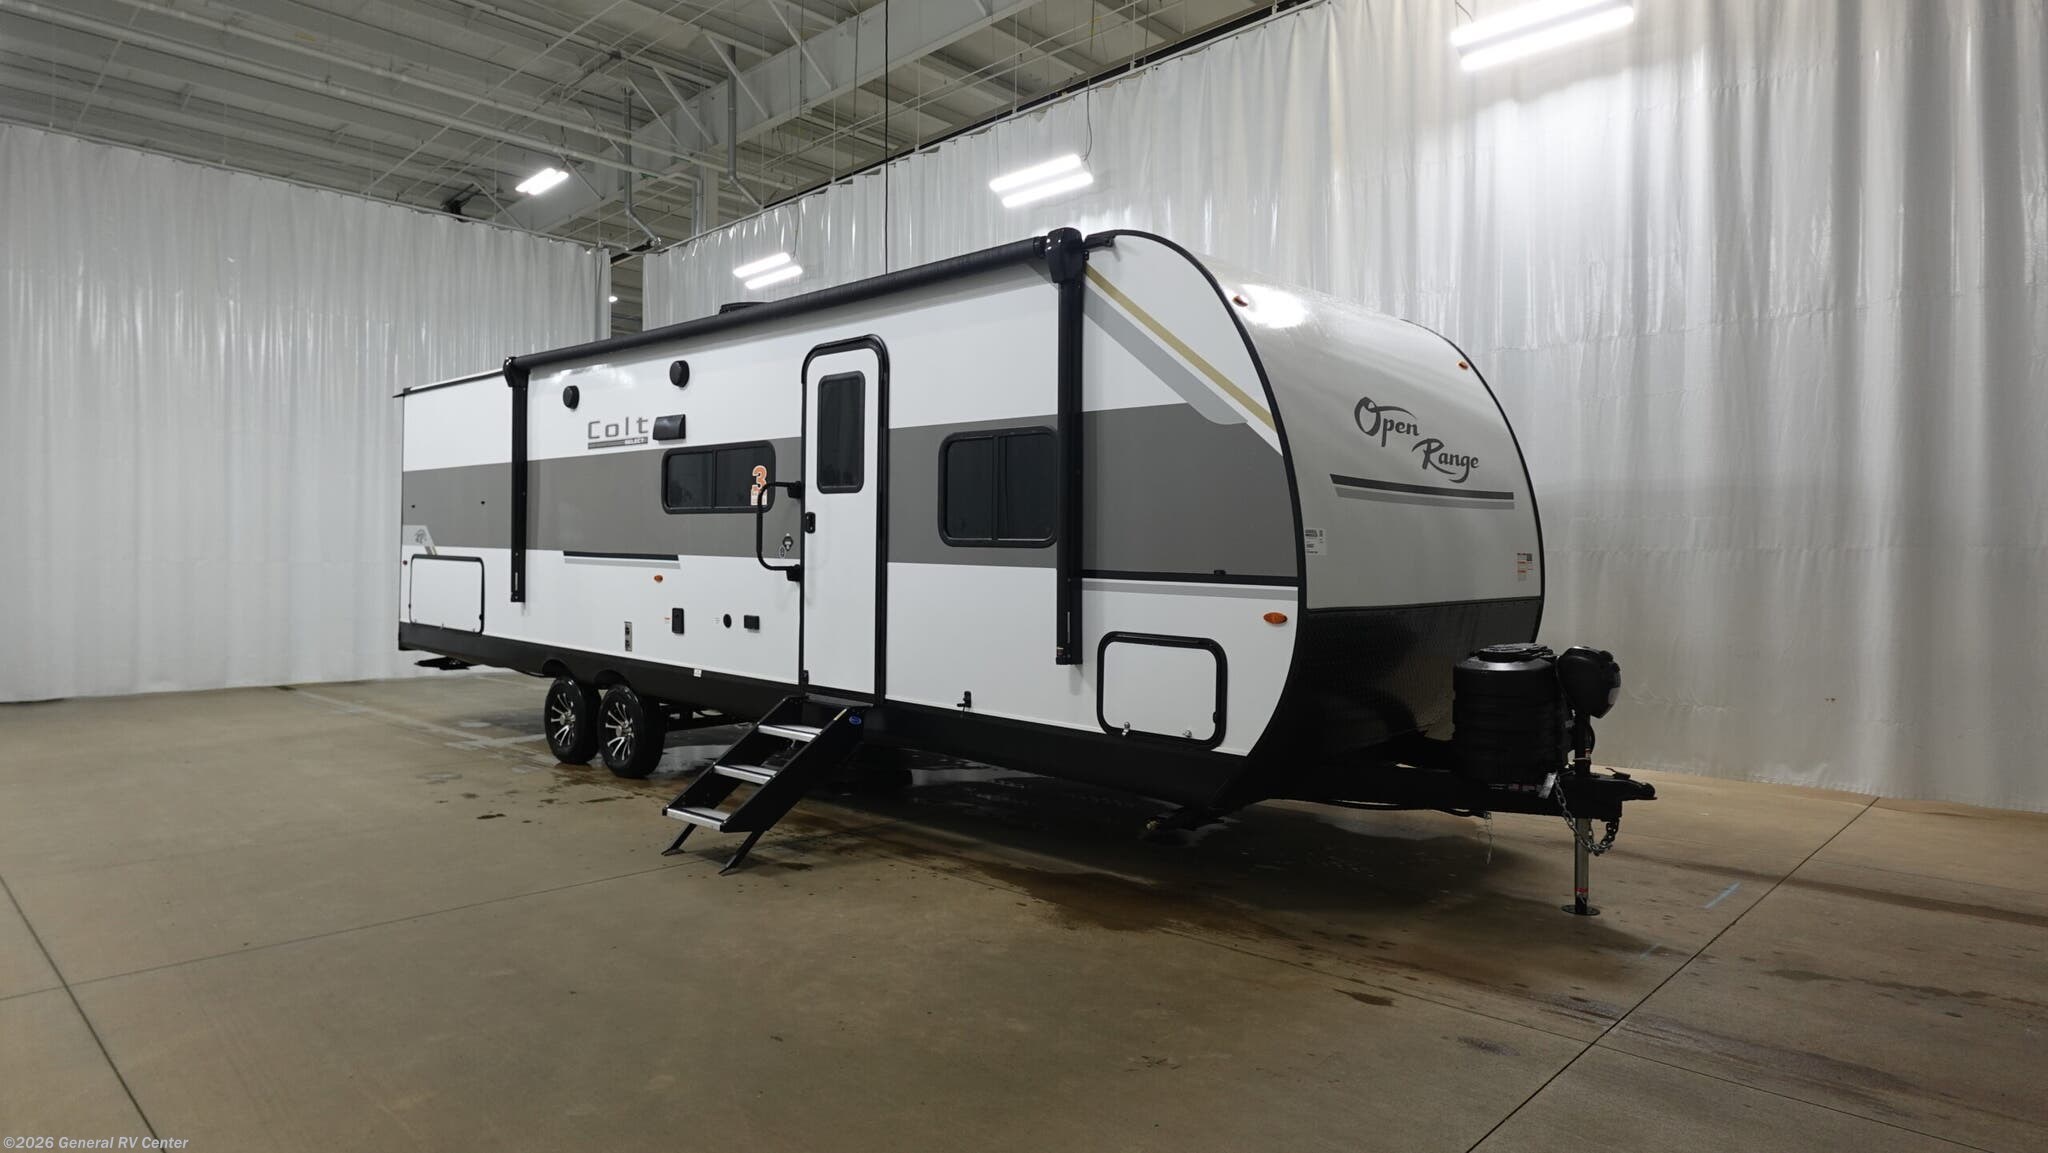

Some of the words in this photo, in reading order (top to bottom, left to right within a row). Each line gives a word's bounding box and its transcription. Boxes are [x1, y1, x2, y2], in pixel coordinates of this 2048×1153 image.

[588, 416, 649, 440] Colt
[1354, 396, 1420, 448] Open
[752, 465, 767, 490] 3
[1411, 438, 1479, 484] Range
